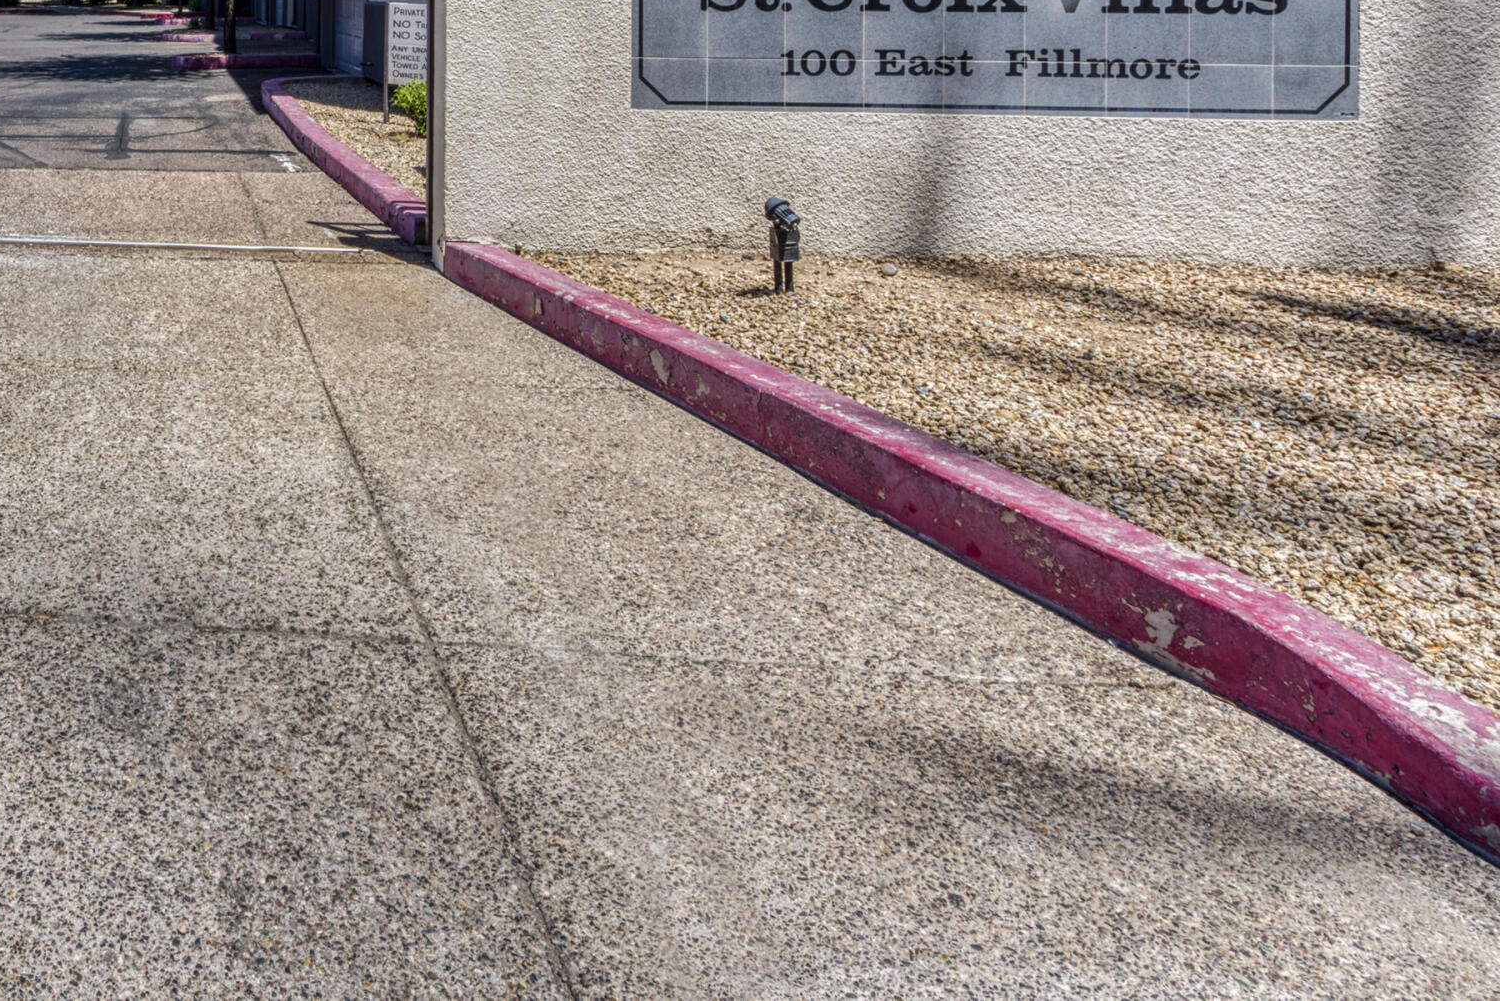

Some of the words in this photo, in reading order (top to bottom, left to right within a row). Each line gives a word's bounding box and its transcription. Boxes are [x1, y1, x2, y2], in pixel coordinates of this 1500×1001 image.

[393, 6, 426, 17] PRIVATE
[393, 20, 411, 29] NO
[415, 20, 428, 29] TR
[392, 31, 411, 40] NO
[414, 32, 427, 41] SO
[391, 53, 421, 62] VEHICLE
[391, 60, 419, 70] TOWED
[780, 49, 857, 77] 100
[874, 49, 974, 77] East
[1004, 48, 1201, 80] Fillmore
